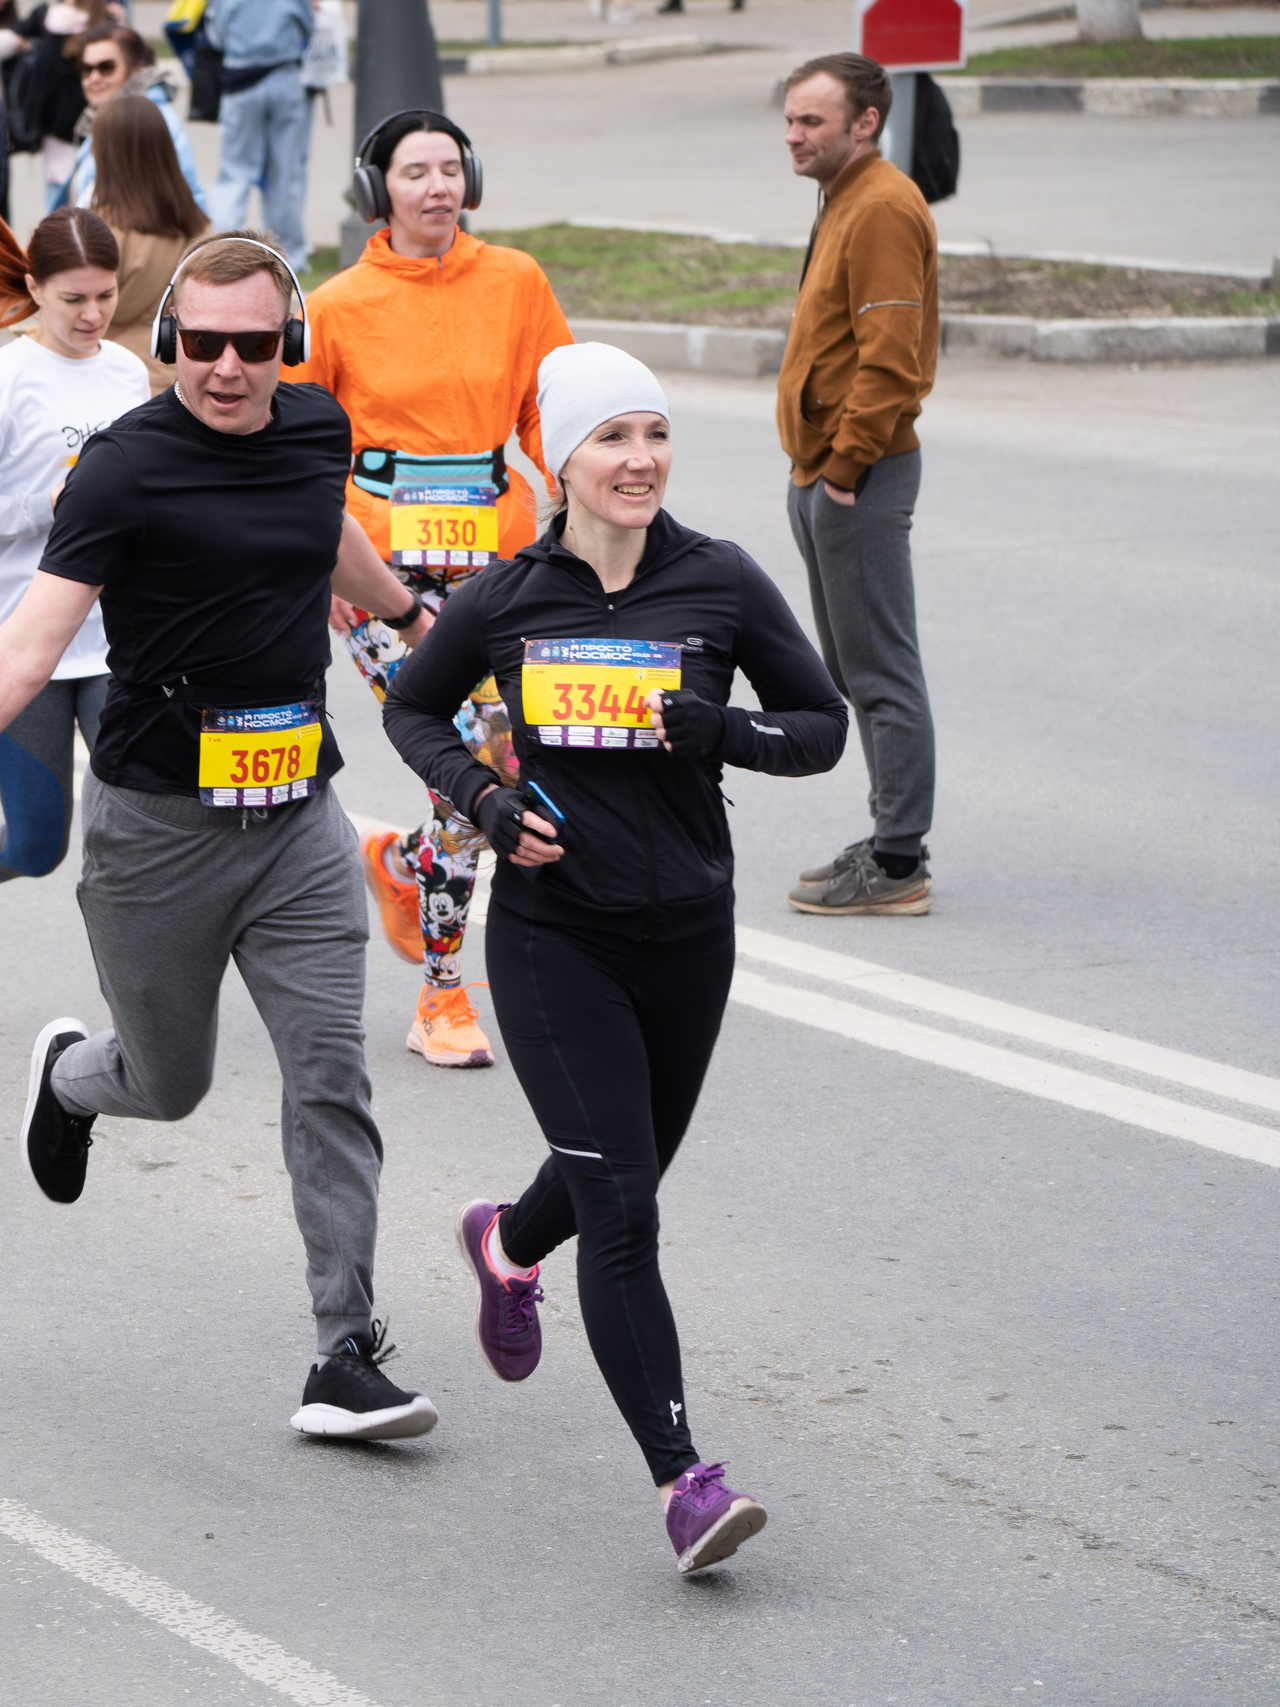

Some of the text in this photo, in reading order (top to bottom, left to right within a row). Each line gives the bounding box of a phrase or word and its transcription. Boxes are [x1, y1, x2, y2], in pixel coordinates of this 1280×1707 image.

[417, 519, 476, 546] 3130
[570, 651, 632, 660] КОСМОС
[580, 644, 632, 652] ПРОСТО
[552, 683, 648, 723] 3344
[230, 745, 301, 783] 3678
